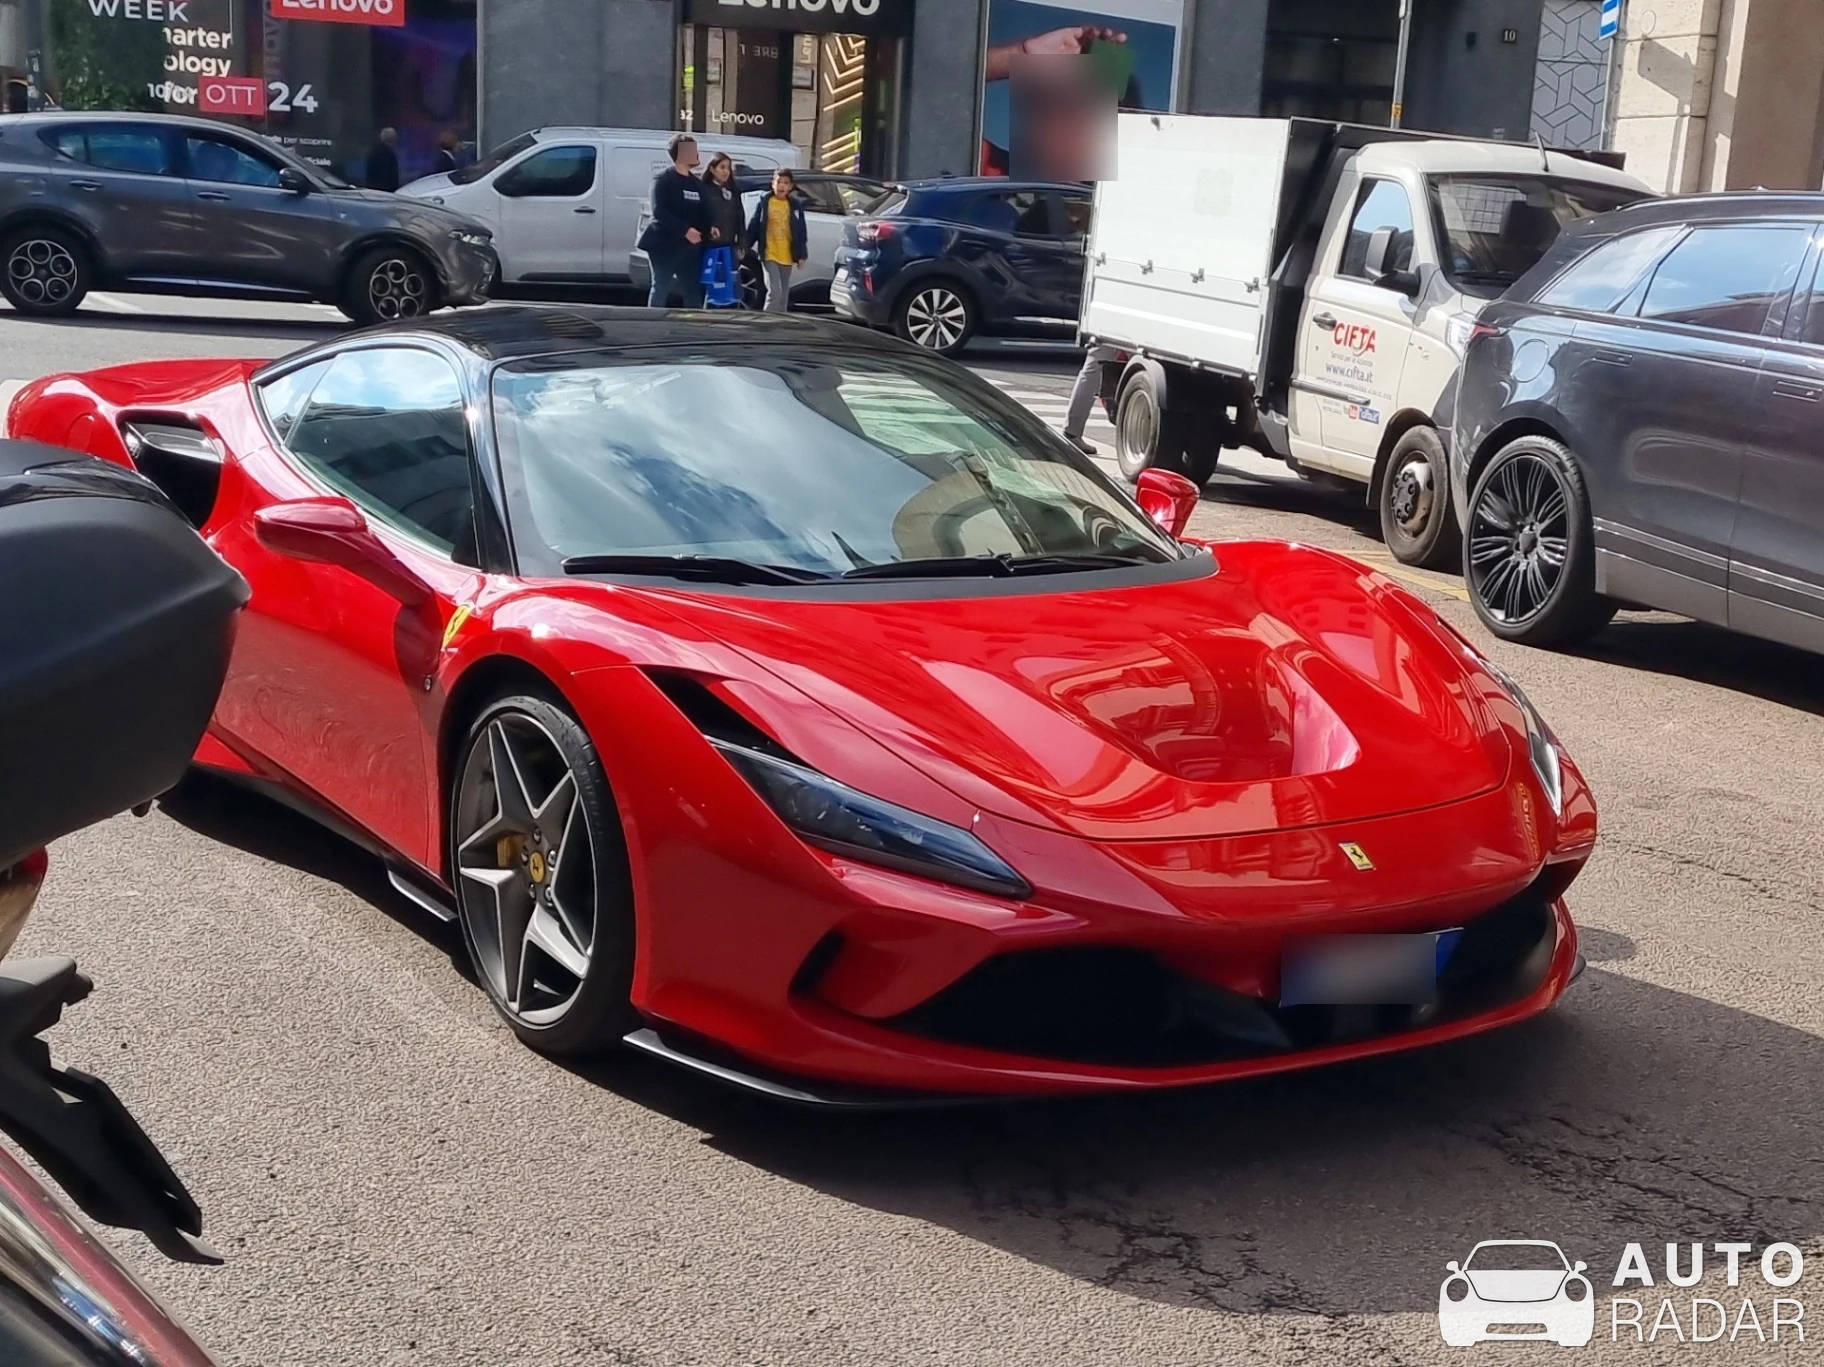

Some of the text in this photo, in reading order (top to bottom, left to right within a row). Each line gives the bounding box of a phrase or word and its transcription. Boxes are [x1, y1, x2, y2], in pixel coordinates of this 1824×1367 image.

[89, 0, 189, 22] WEEK
[1503, 29, 1516, 42] 10
[206, 84, 257, 106] OTT
[268, 81, 319, 113] 24
[711, 110, 765, 125] Lenovo
[1334, 323, 1376, 353] CIFTA
[1325, 363, 1373, 383] www.cifta.it
